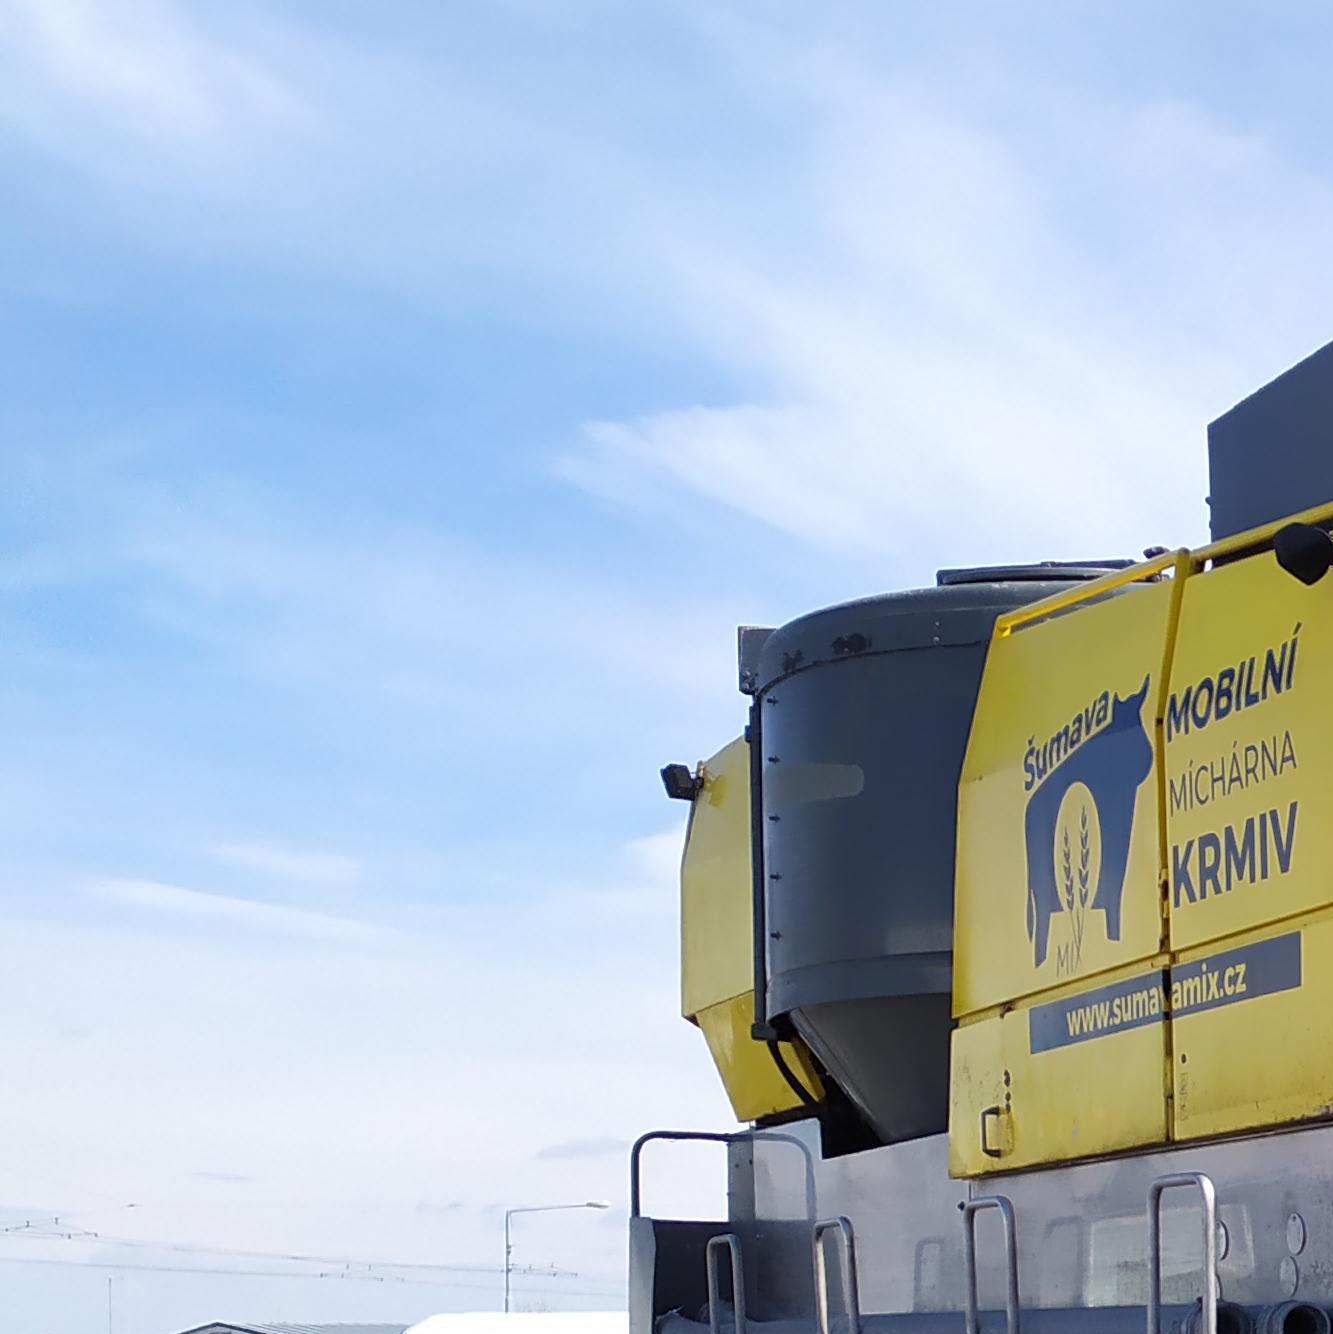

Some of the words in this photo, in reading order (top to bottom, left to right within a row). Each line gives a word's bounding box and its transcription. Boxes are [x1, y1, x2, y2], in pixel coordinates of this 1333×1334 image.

[1167, 620, 1303, 744] MOBILNÍ
[1022, 689, 1111, 793] Šumava
[1168, 729, 1298, 818] MÍCHÁRNA
[1171, 800, 1299, 910] KRMIV
